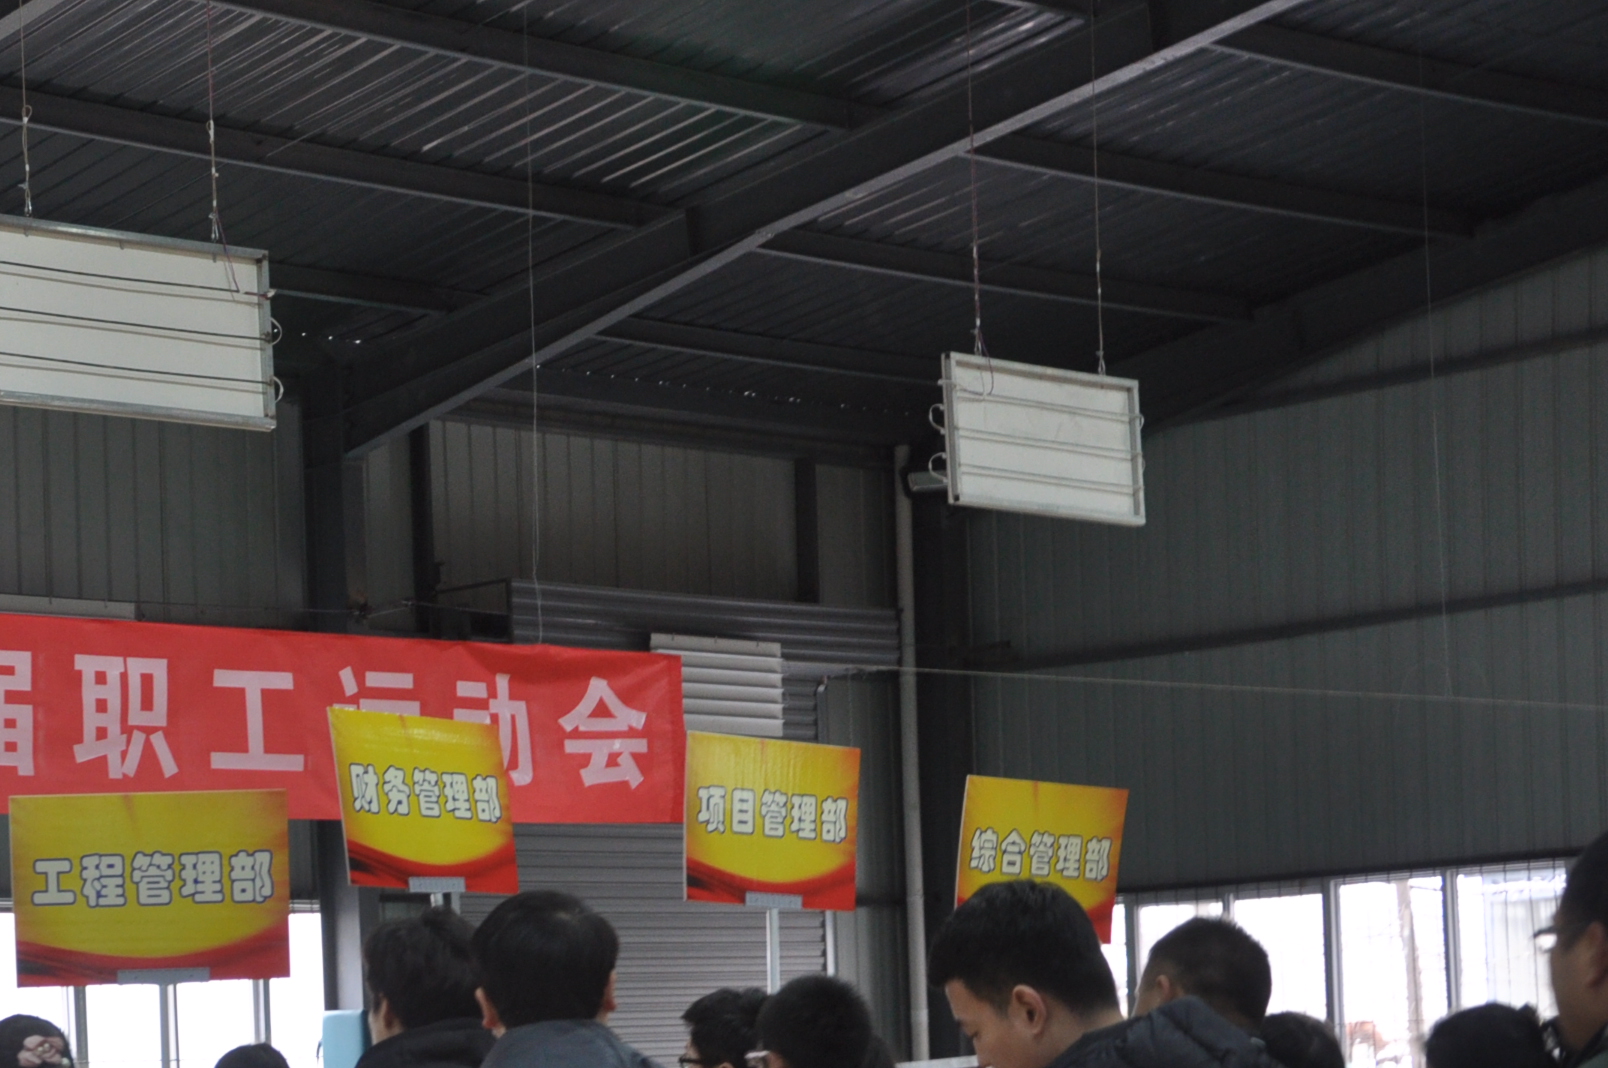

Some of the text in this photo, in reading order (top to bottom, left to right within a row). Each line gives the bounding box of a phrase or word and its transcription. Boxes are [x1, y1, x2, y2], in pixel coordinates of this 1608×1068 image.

[349, 763, 502, 823] 财务管理部
[696, 785, 848, 843] 项目管理部
[31, 850, 274, 908] 工程管理部
[969, 828, 1113, 882] 综合管理部
